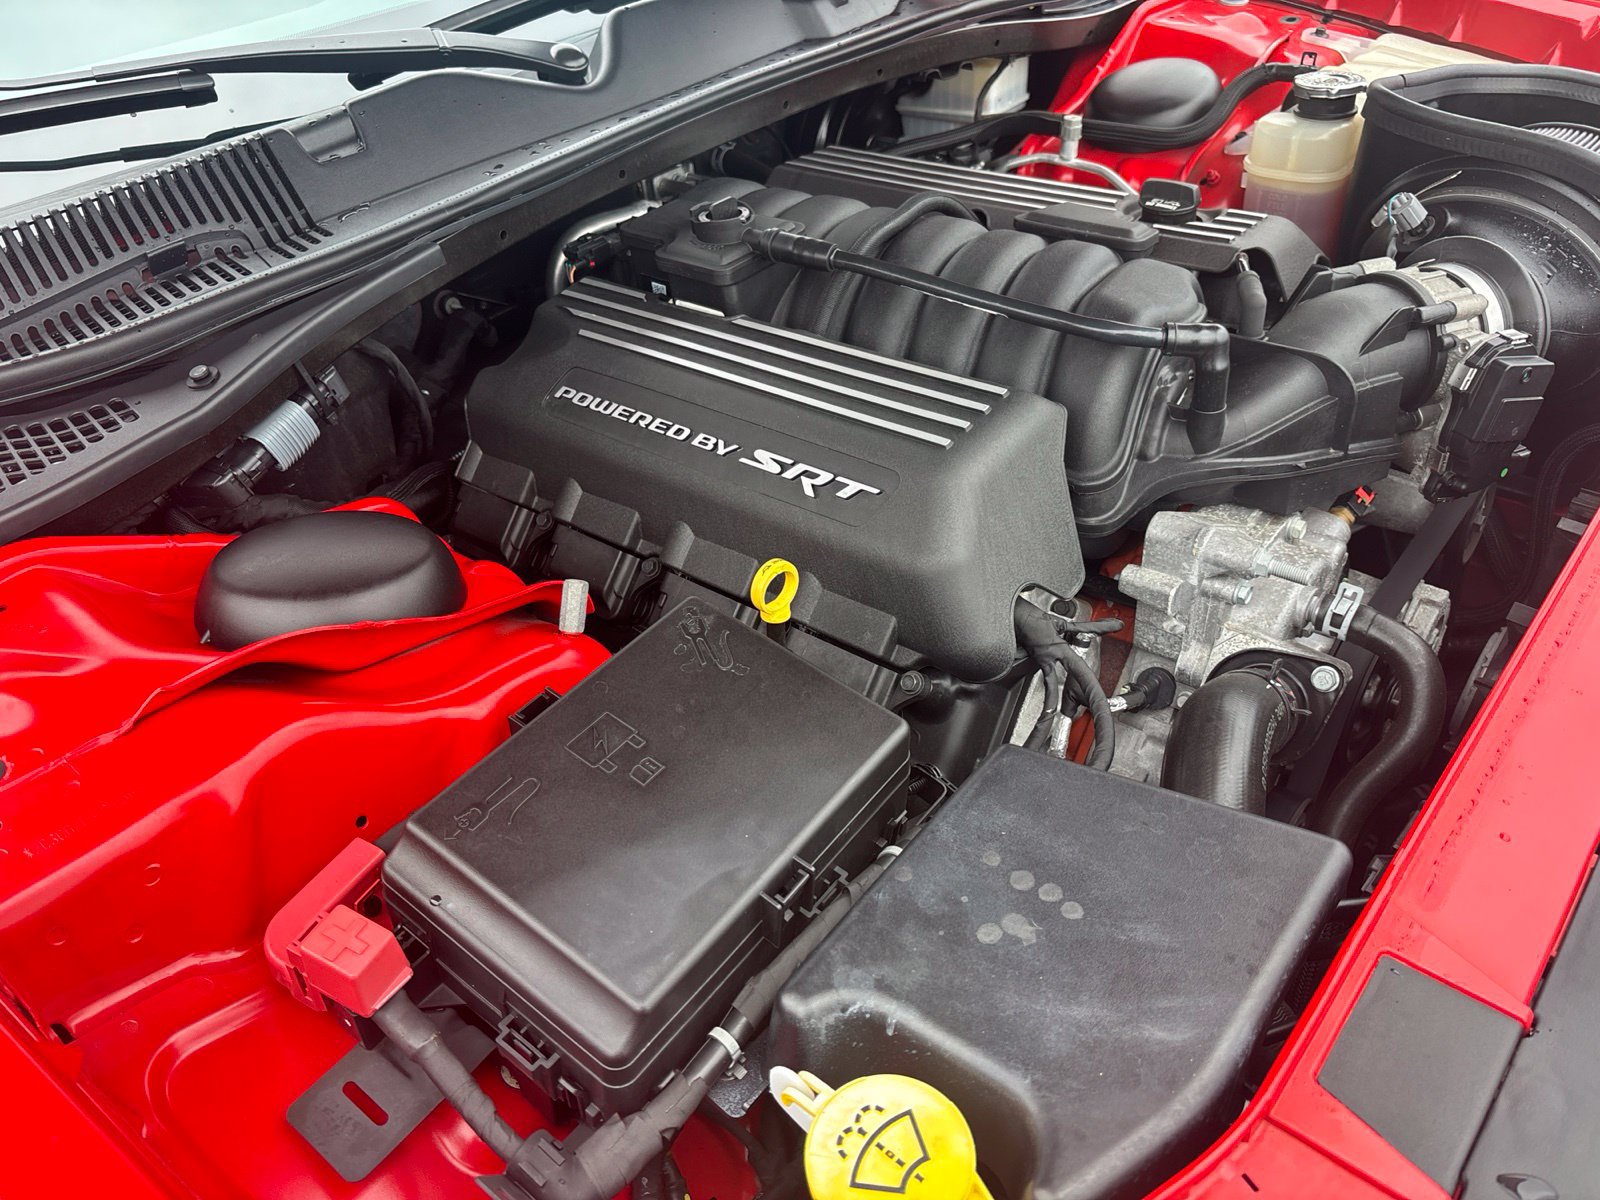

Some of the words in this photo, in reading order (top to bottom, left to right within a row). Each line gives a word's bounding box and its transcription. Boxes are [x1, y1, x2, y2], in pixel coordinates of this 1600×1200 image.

[554, 386, 692, 441] POWERED
[691, 433, 740, 456] BY
[739, 449, 881, 499] SRT
